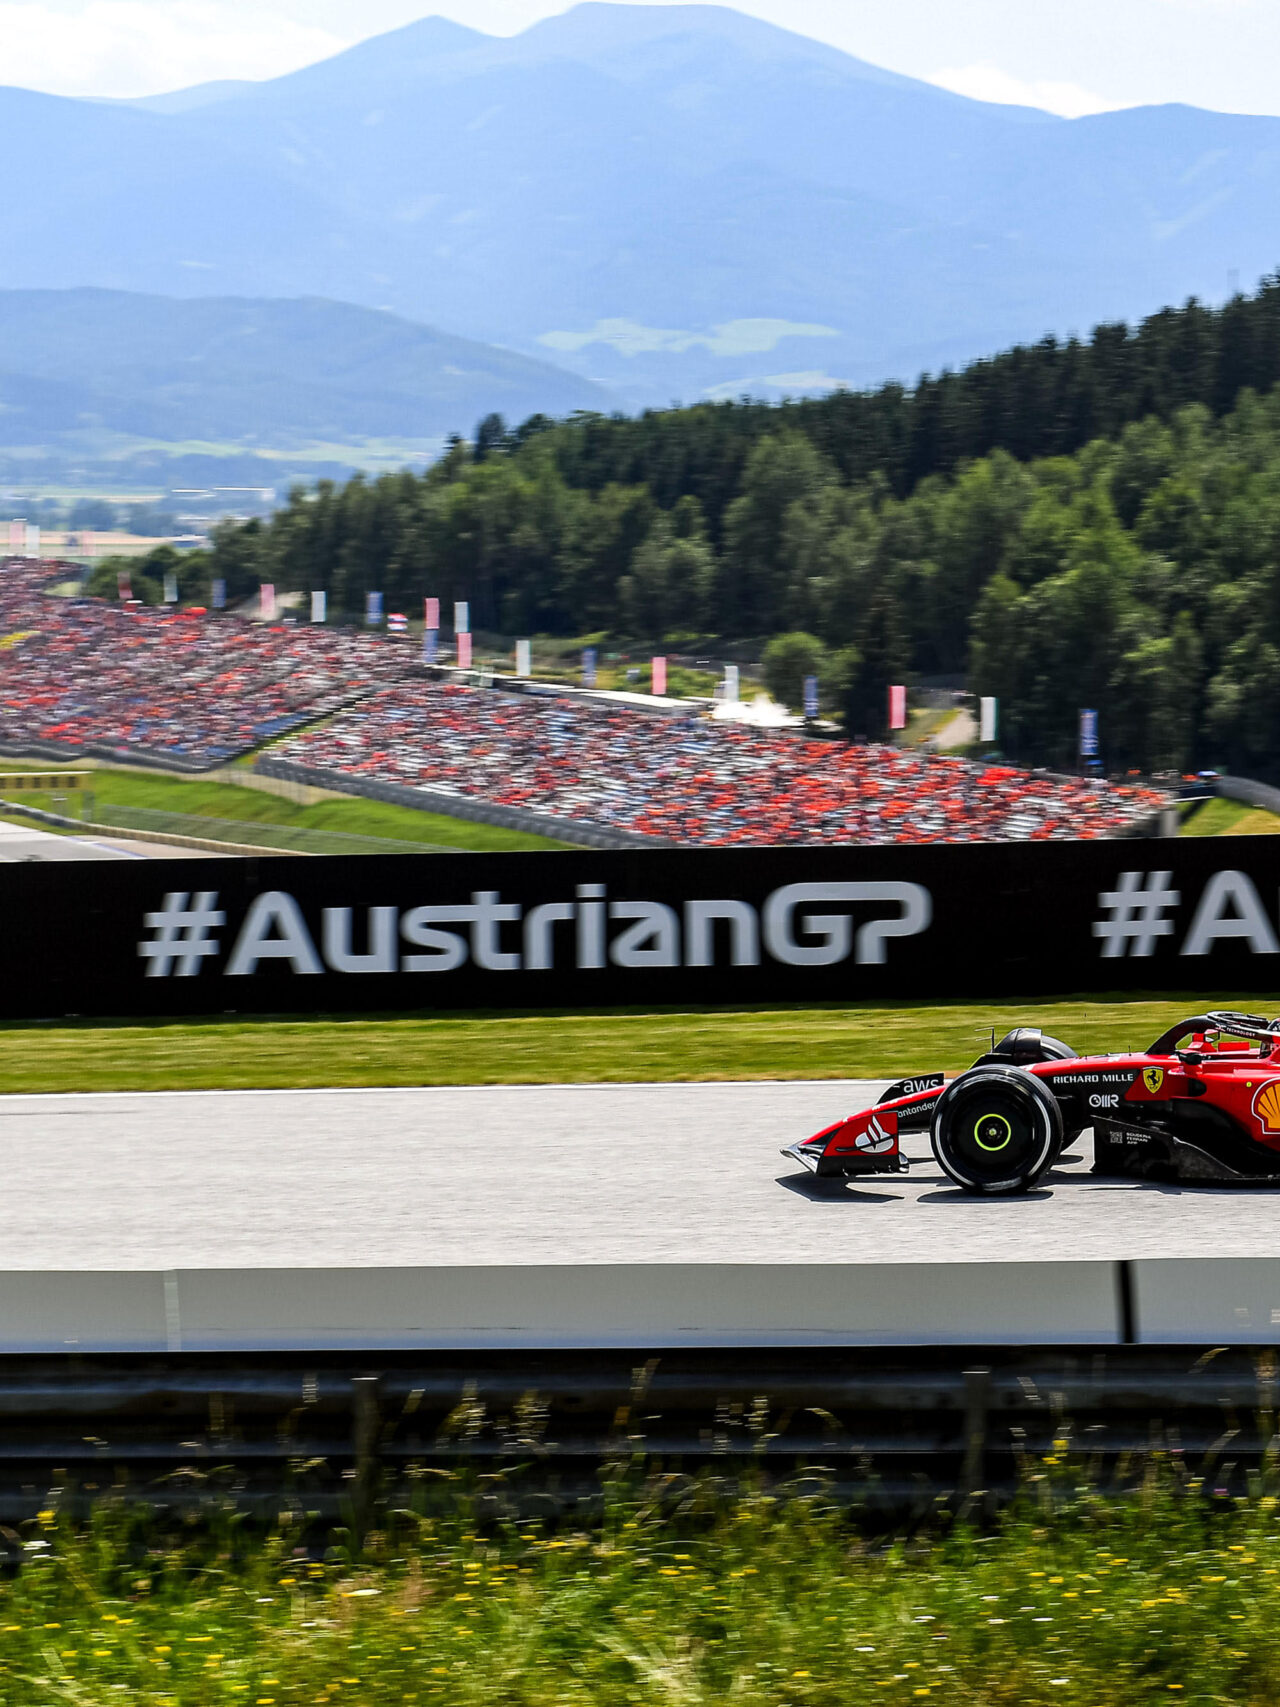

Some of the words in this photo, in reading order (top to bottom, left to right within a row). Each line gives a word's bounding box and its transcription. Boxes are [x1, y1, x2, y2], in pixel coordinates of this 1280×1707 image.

[139, 880, 930, 978] #AustrianGP
[1053, 1074, 1099, 1084] RICHARD
[1102, 1073, 1134, 1082] MILLE
[903, 1079, 939, 1093] aws
